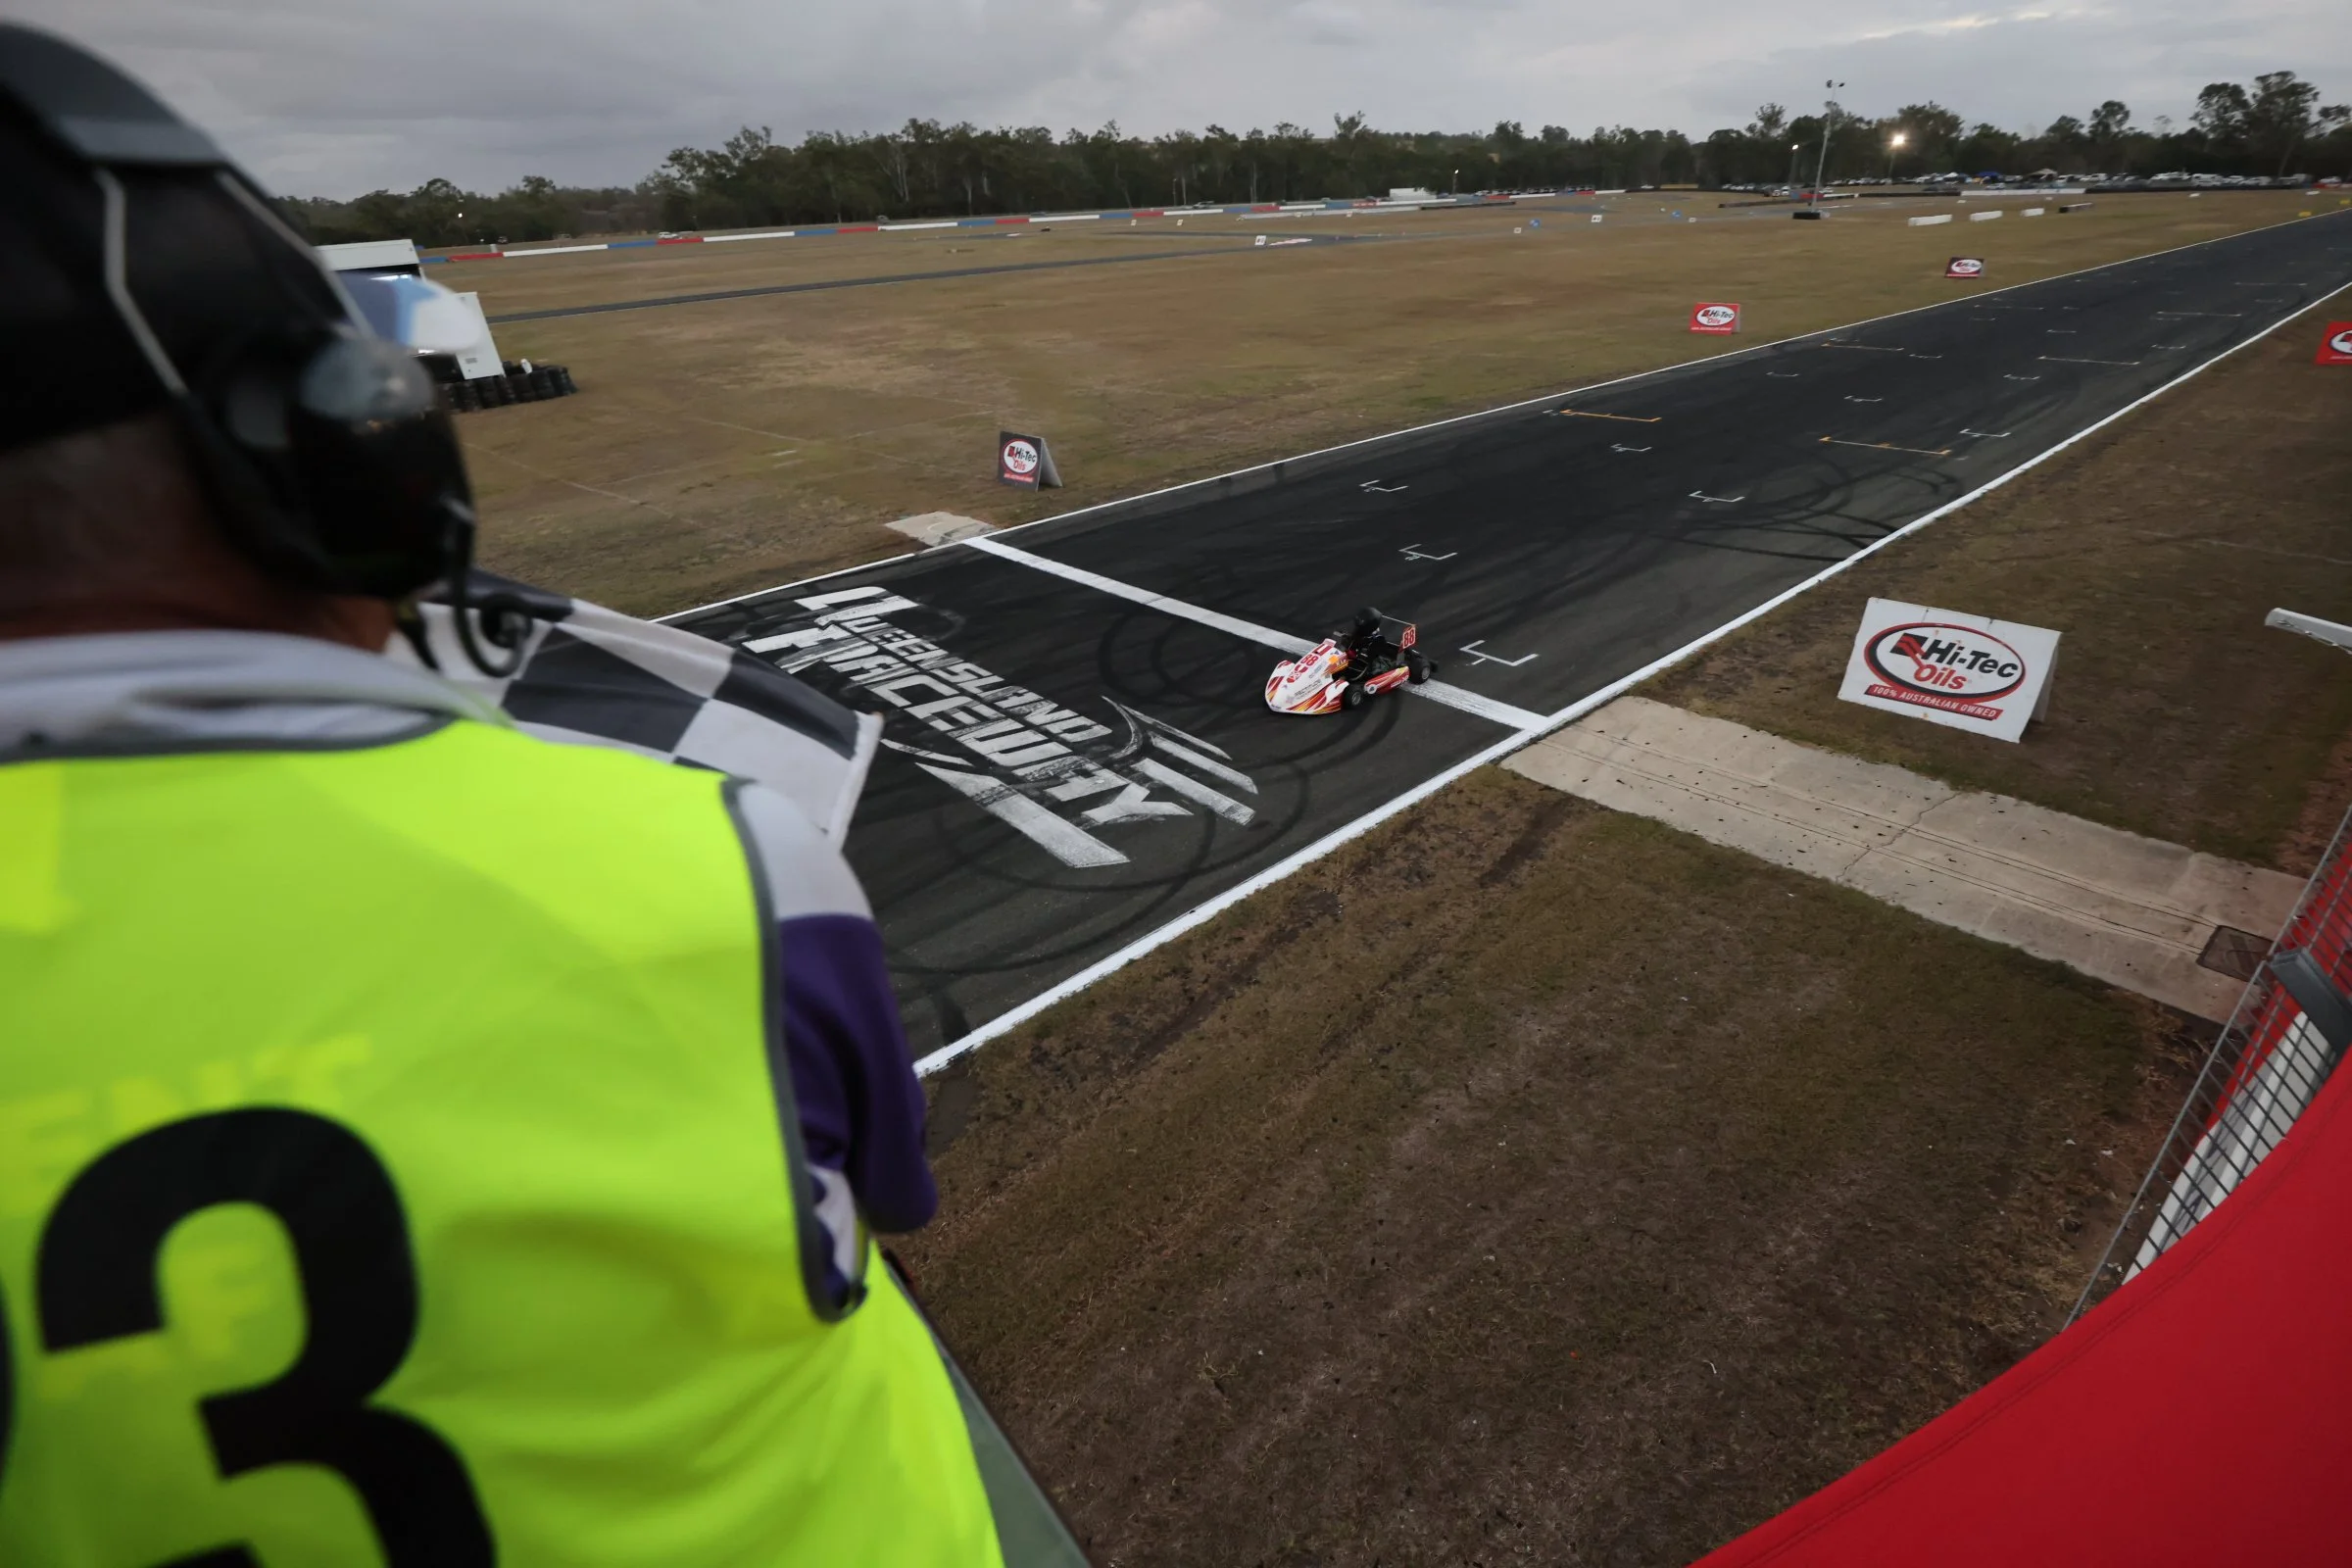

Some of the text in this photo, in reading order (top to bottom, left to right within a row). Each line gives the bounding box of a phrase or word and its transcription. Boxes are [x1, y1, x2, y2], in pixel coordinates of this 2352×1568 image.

[1013, 460, 1027, 471] Oils
[1014, 446, 1037, 463] Hi-Tec
[1403, 628, 1416, 648] 88
[1922, 638, 2019, 678] Hi-Tec
[1913, 663, 1968, 690] Oils
[1873, 686, 1997, 718] 100% AUSTRALIAN OWNED
